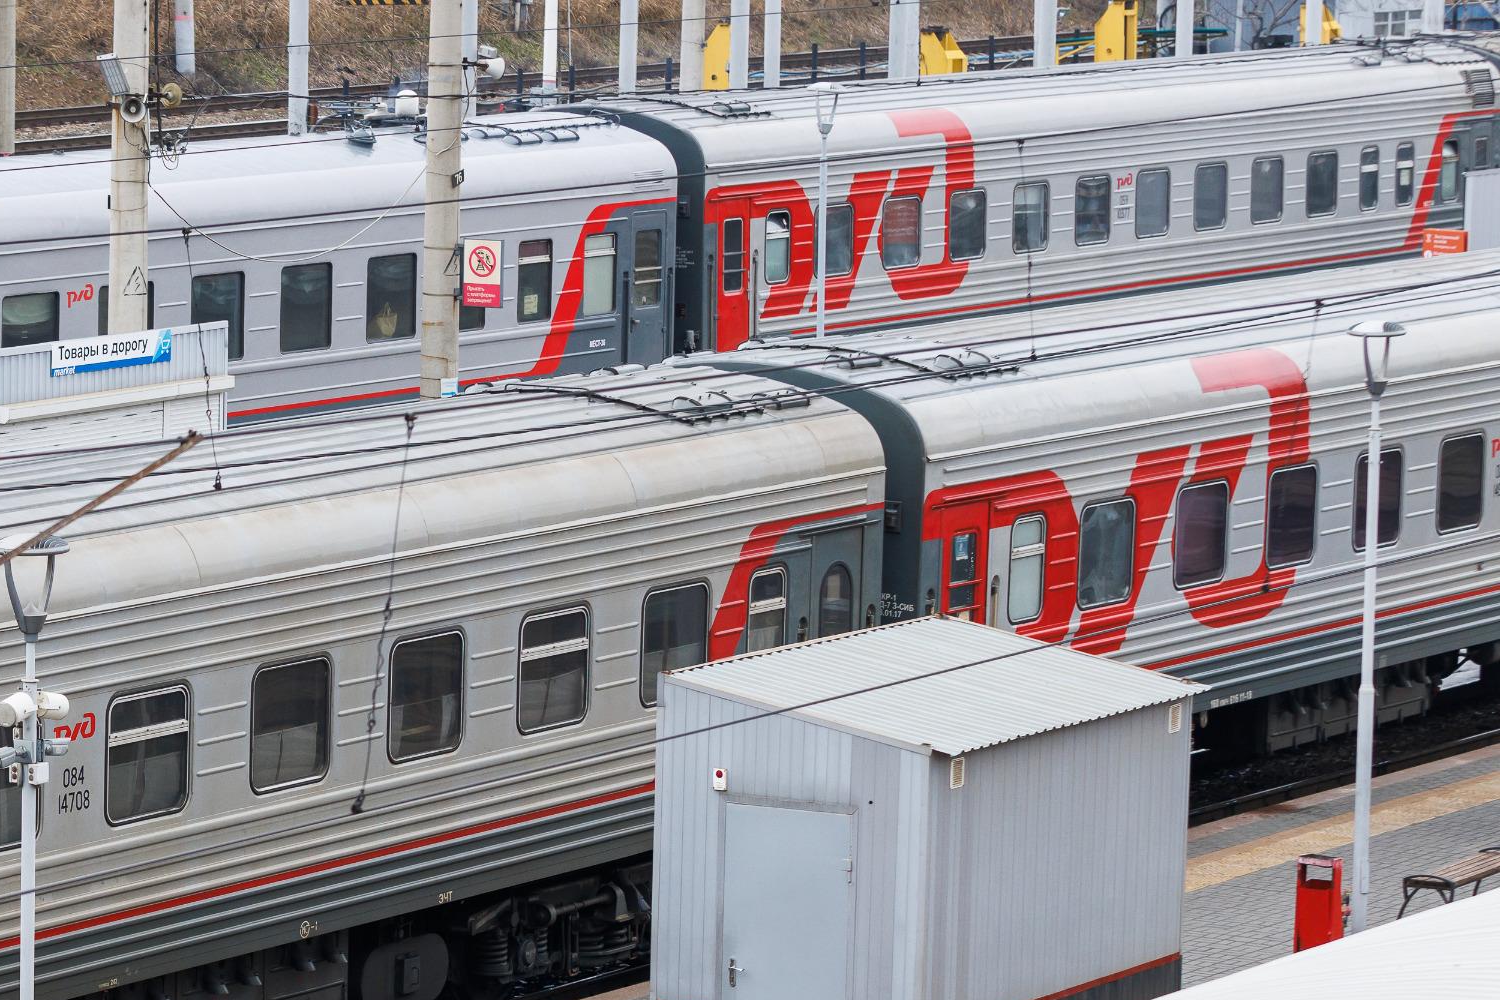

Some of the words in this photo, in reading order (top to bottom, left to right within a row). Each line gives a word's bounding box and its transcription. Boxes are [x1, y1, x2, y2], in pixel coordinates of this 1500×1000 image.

[58, 345, 99, 361] Товары
[102, 343, 109, 355] в
[110, 339, 149, 356] дорогу
[63, 765, 85, 788] 084
[58, 790, 90, 815] 14708
